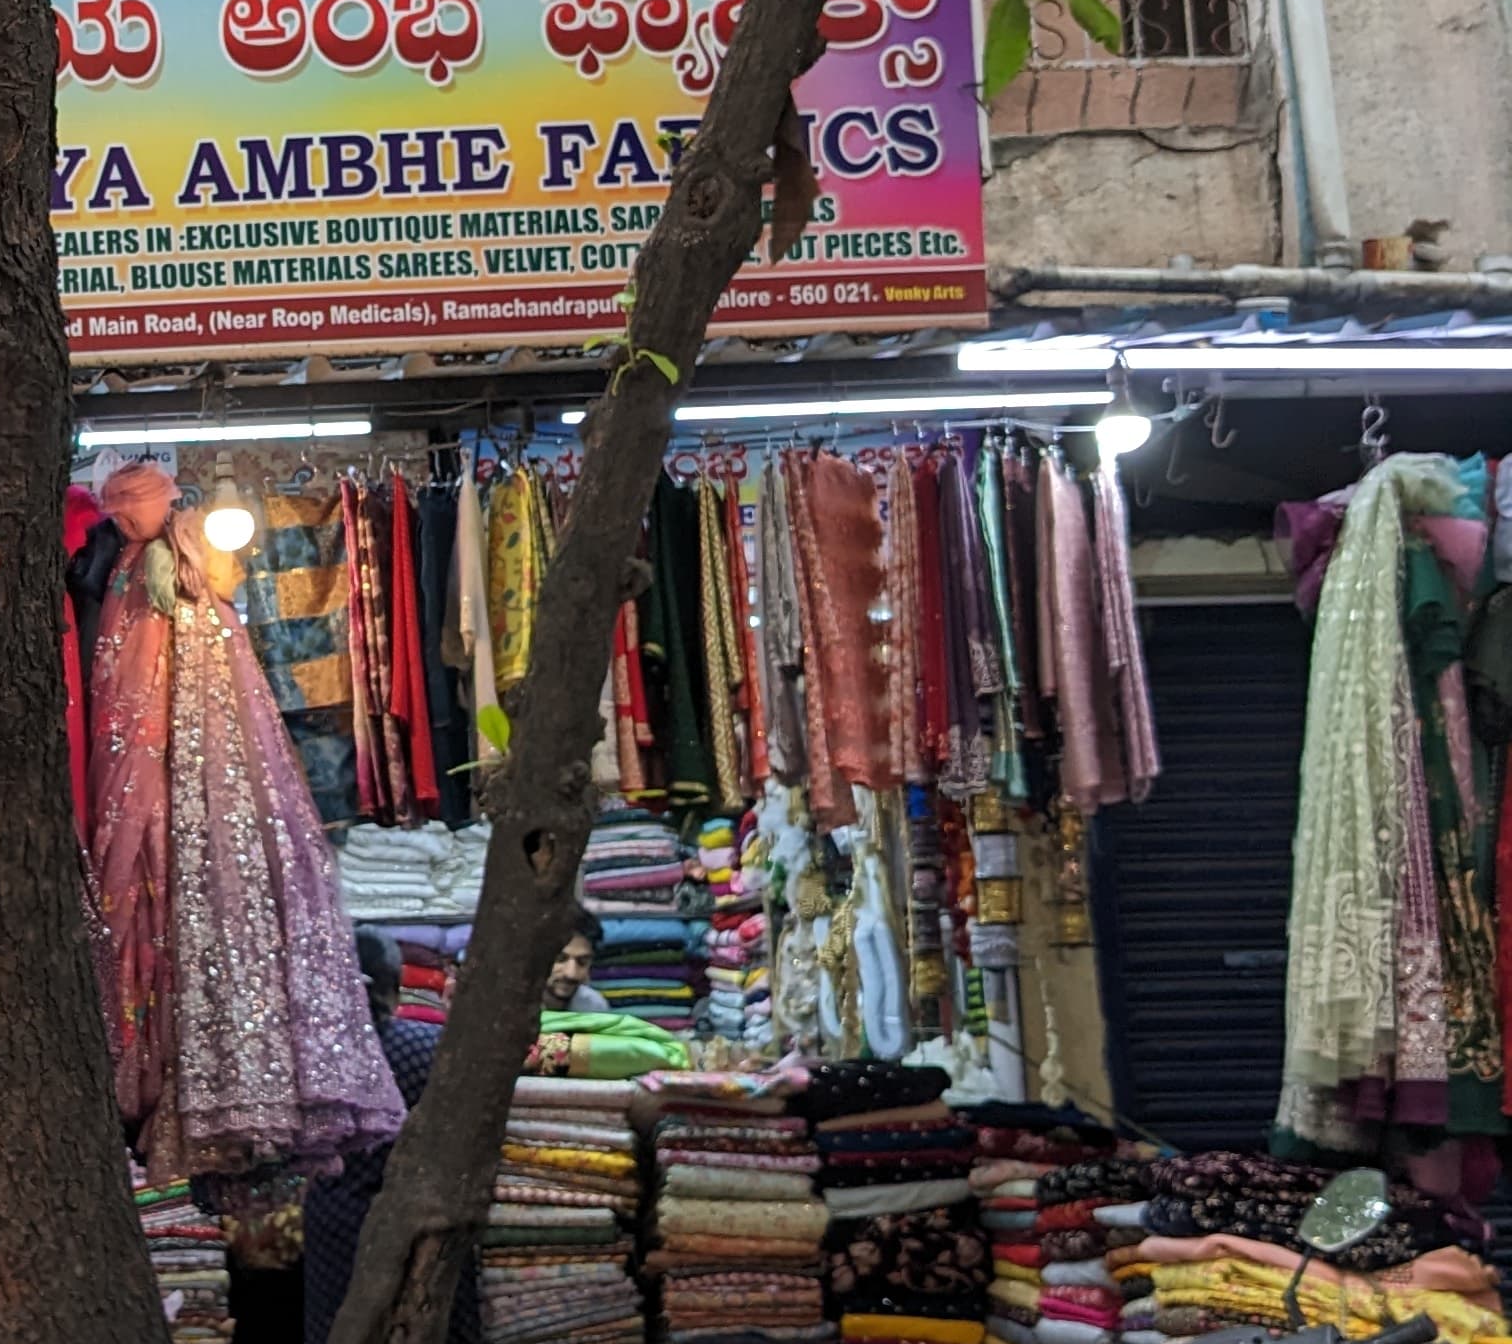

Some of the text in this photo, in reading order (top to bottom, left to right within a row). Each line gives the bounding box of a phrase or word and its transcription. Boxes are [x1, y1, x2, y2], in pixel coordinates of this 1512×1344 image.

[50, 107, 939, 211] YA AMBHE FACS
[54, 228, 140, 257] EALERS
[146, 226, 172, 252] IN
[327, 213, 453, 246] BOUTIQUE
[461, 207, 605, 239] MATERIALS,
[610, 205, 661, 232] SAR
[57, 265, 125, 294] RIAL,
[131, 258, 227, 290] BLOUSE
[233, 253, 372, 285] MATERIALS
[379, 248, 479, 280] SAREES,
[485, 244, 576, 275] VELVET,
[825, 230, 913, 259] PIECES
[919, 230, 965, 257] Etc.
[88, 315, 139, 337] Main
[145, 312, 203, 336] Road,
[209, 307, 266, 333] (Near
[272, 306, 324, 331] Roop
[330, 299, 437, 328] Medicals),
[443, 290, 625, 322] Ramachandrapur
[713, 289, 771, 312] alore
[790, 284, 827, 305] 560
[834, 281, 879, 304] 021.
[885, 287, 931, 304] Venky
[934, 285, 965, 299] Arts
